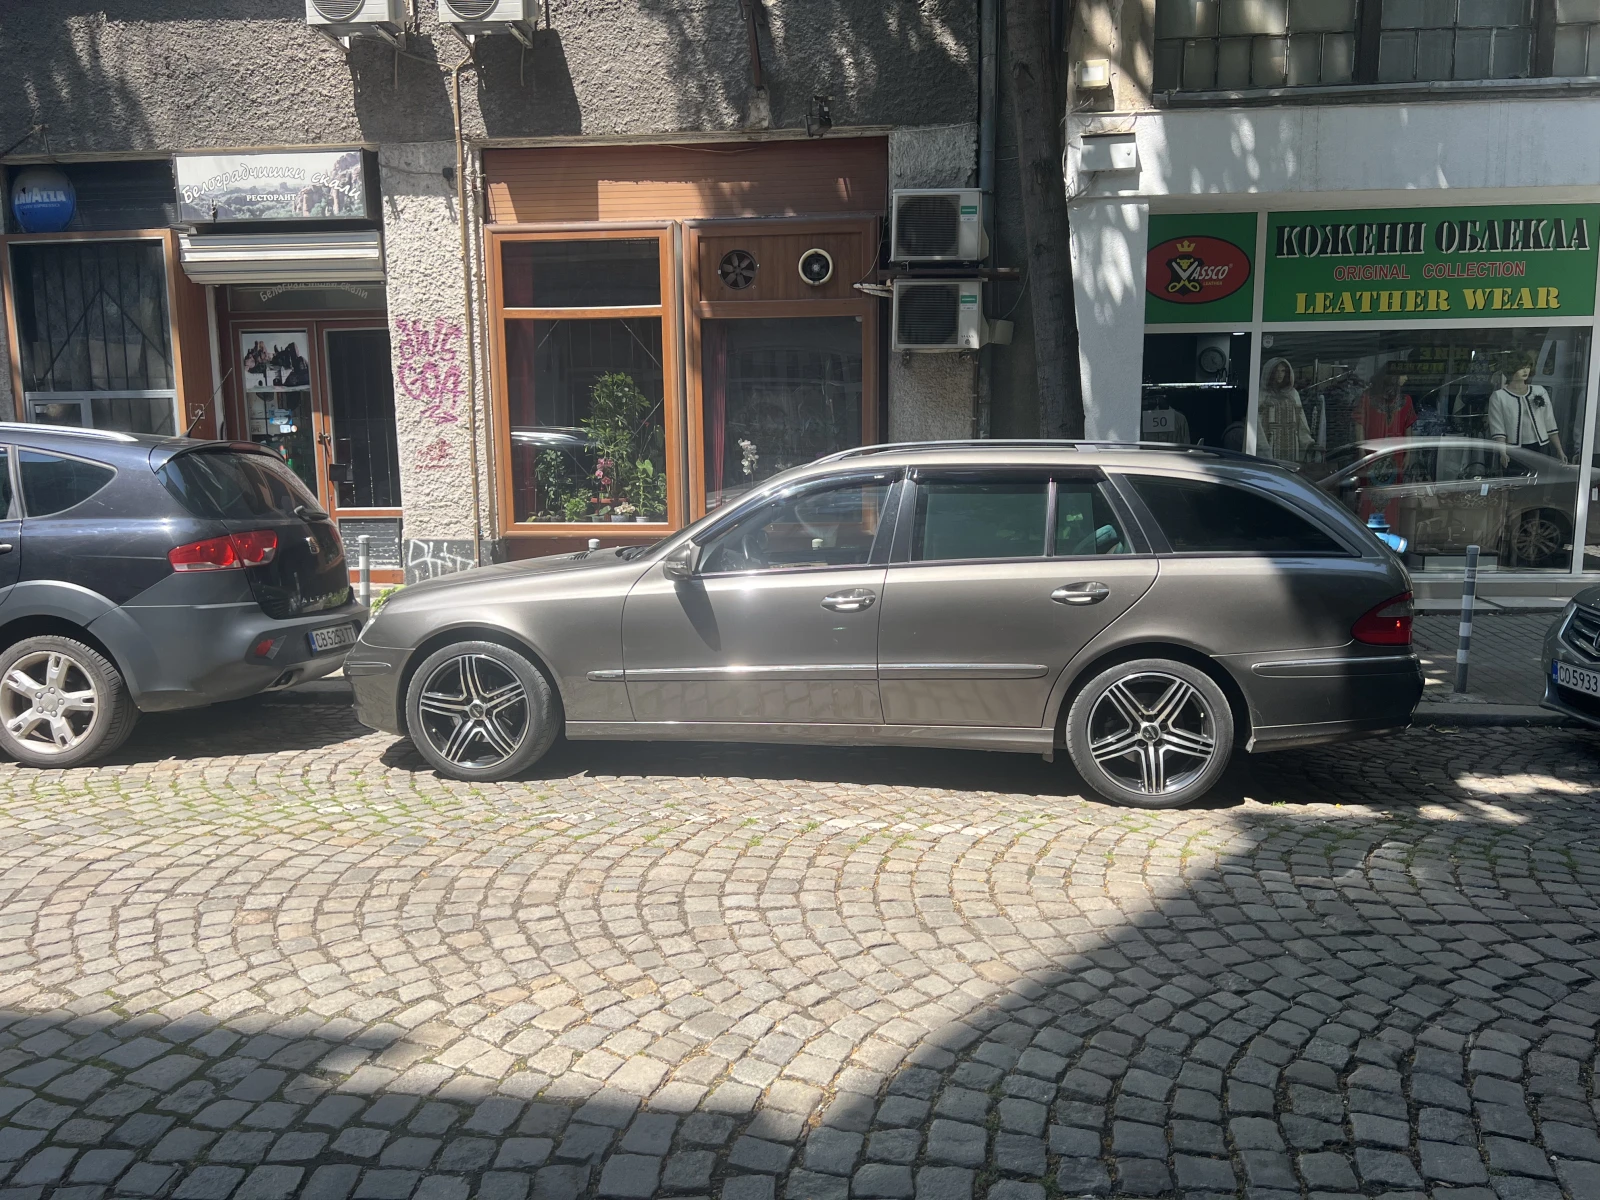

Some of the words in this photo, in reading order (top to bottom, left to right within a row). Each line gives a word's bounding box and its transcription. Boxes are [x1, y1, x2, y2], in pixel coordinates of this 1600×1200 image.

[181, 162, 305, 204] Белоградчишки
[311, 171, 361, 200] скали
[246, 193, 297, 202] РЕСТОРАНТ
[1275, 222, 1427, 258] КОЖЕНИ
[1435, 218, 1590, 254] ОБЛЕКЛА
[1334, 264, 1410, 281] ORIGINAL
[1423, 261, 1526, 279] COLLECTION
[1295, 288, 1451, 315] LEATHER
[1463, 286, 1562, 311] WEAR
[1152, 416, 1168, 428] 50
